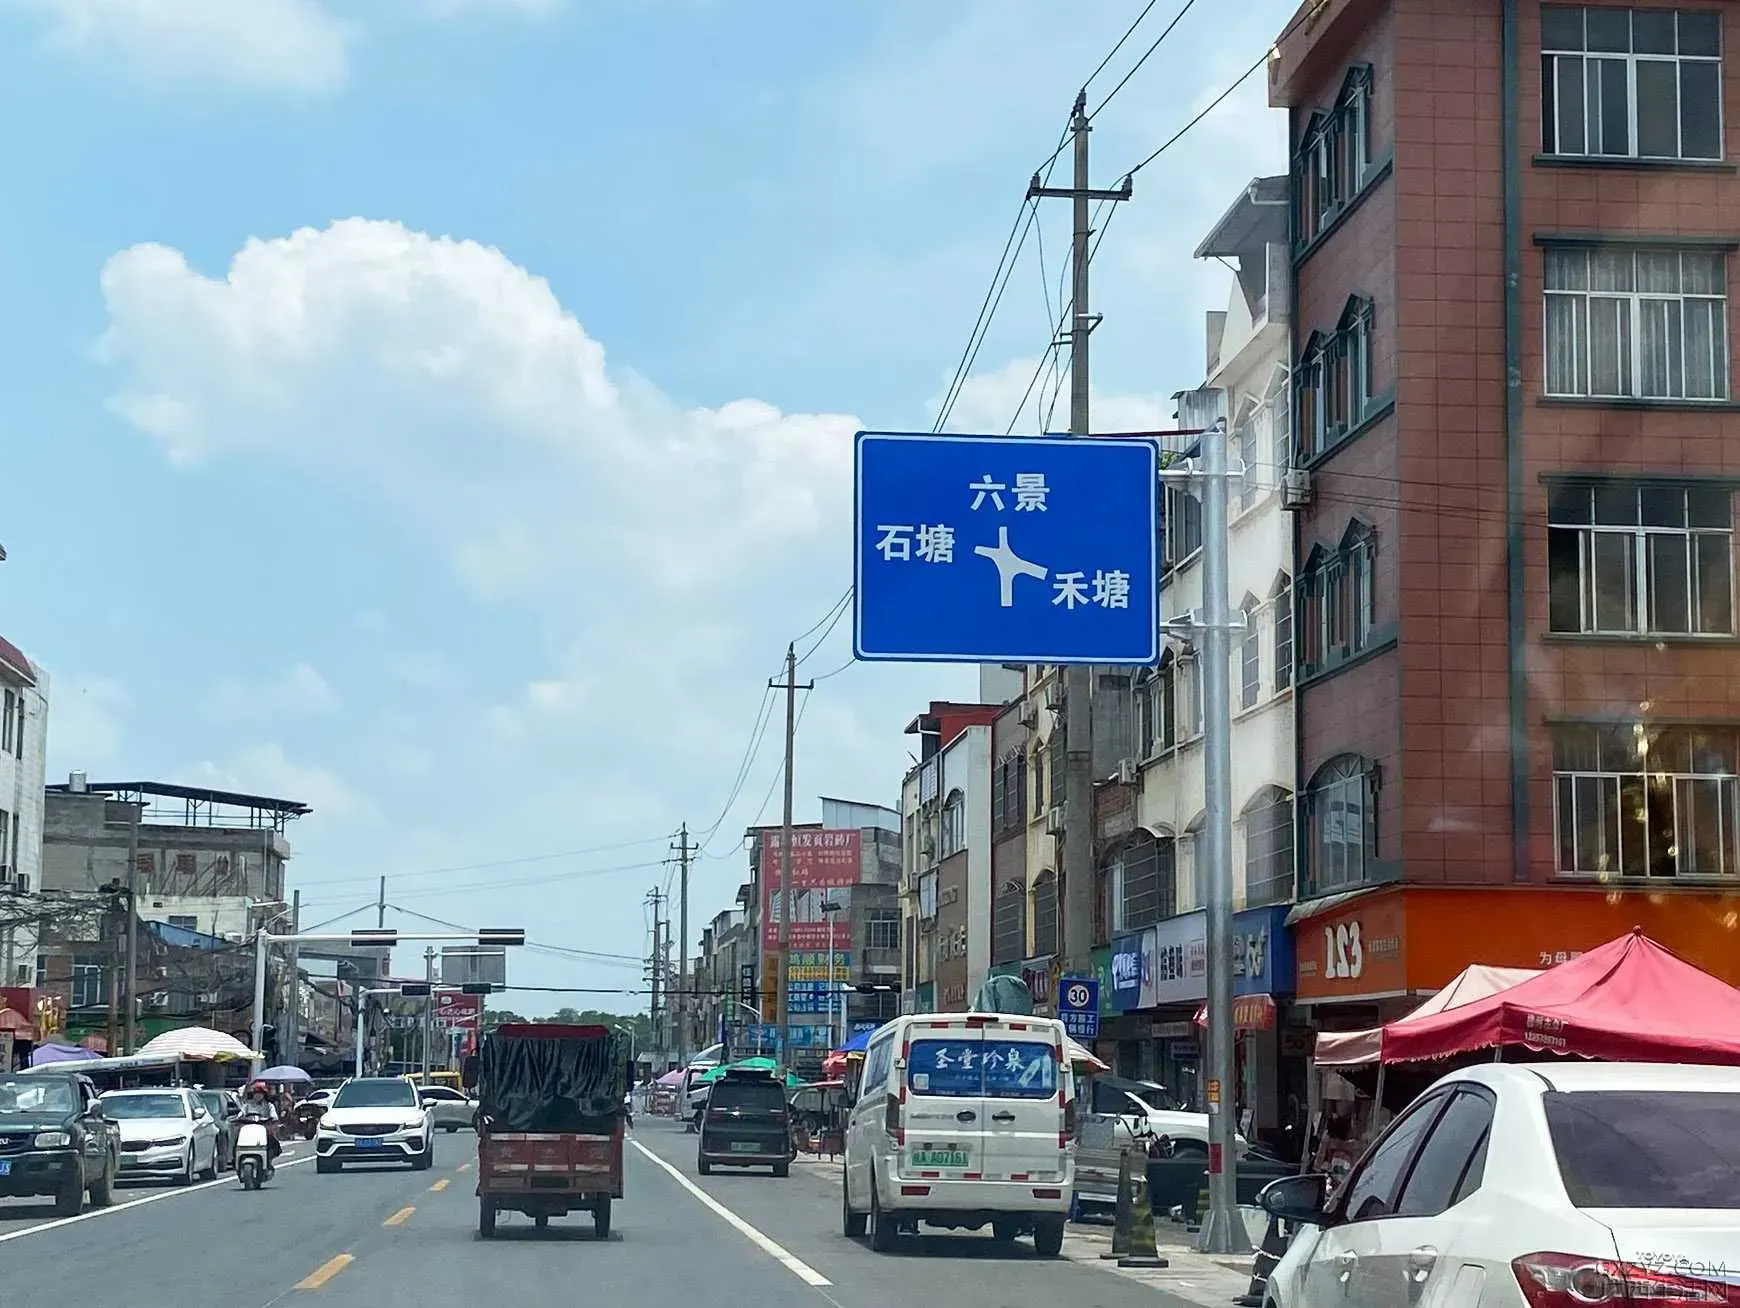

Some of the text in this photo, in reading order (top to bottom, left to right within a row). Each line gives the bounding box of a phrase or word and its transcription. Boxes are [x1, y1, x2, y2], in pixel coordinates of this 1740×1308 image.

[969, 473, 1050, 512] 六景
[875, 523, 956, 563] 石塘
[1051, 569, 1130, 610] 禾塘
[1325, 921, 1363, 978] 123
[1070, 989, 1088, 1003] 30
[1061, 1013, 1096, 1023] 前方施工
